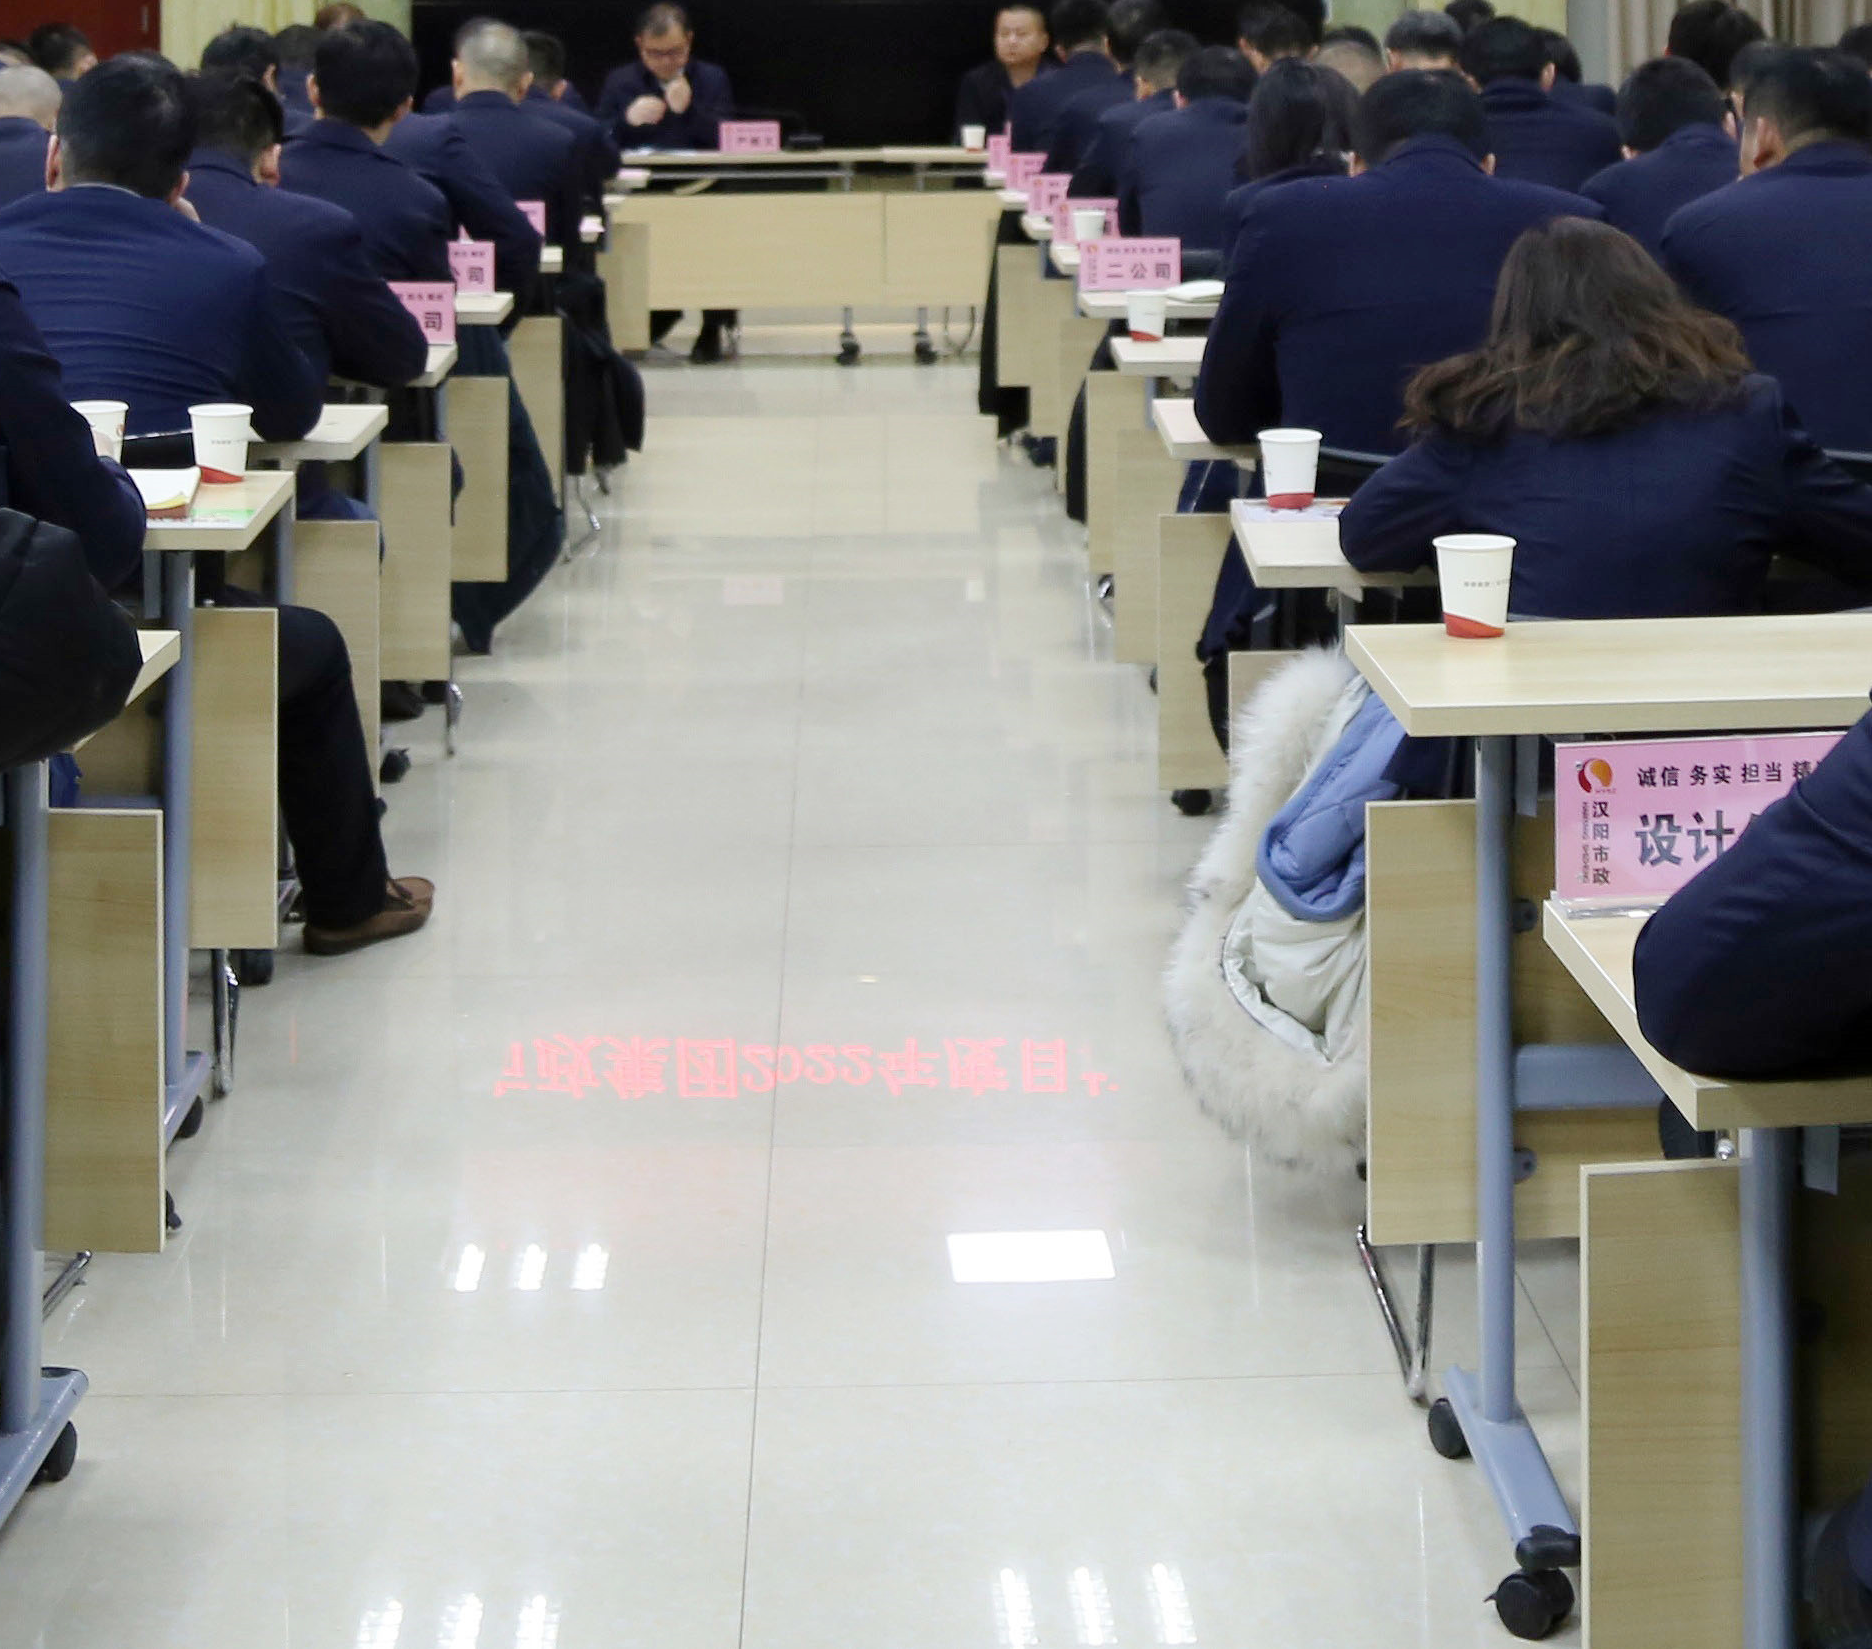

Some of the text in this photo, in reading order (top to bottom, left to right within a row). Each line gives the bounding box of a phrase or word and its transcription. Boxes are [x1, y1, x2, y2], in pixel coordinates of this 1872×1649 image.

[1636, 765, 1681, 789] 诚信
[1689, 762, 1732, 787] 务实
[1741, 760, 1783, 784] 担当
[1592, 800, 1611, 885] 汉阳市政
[1634, 809, 1763, 867] 设计
